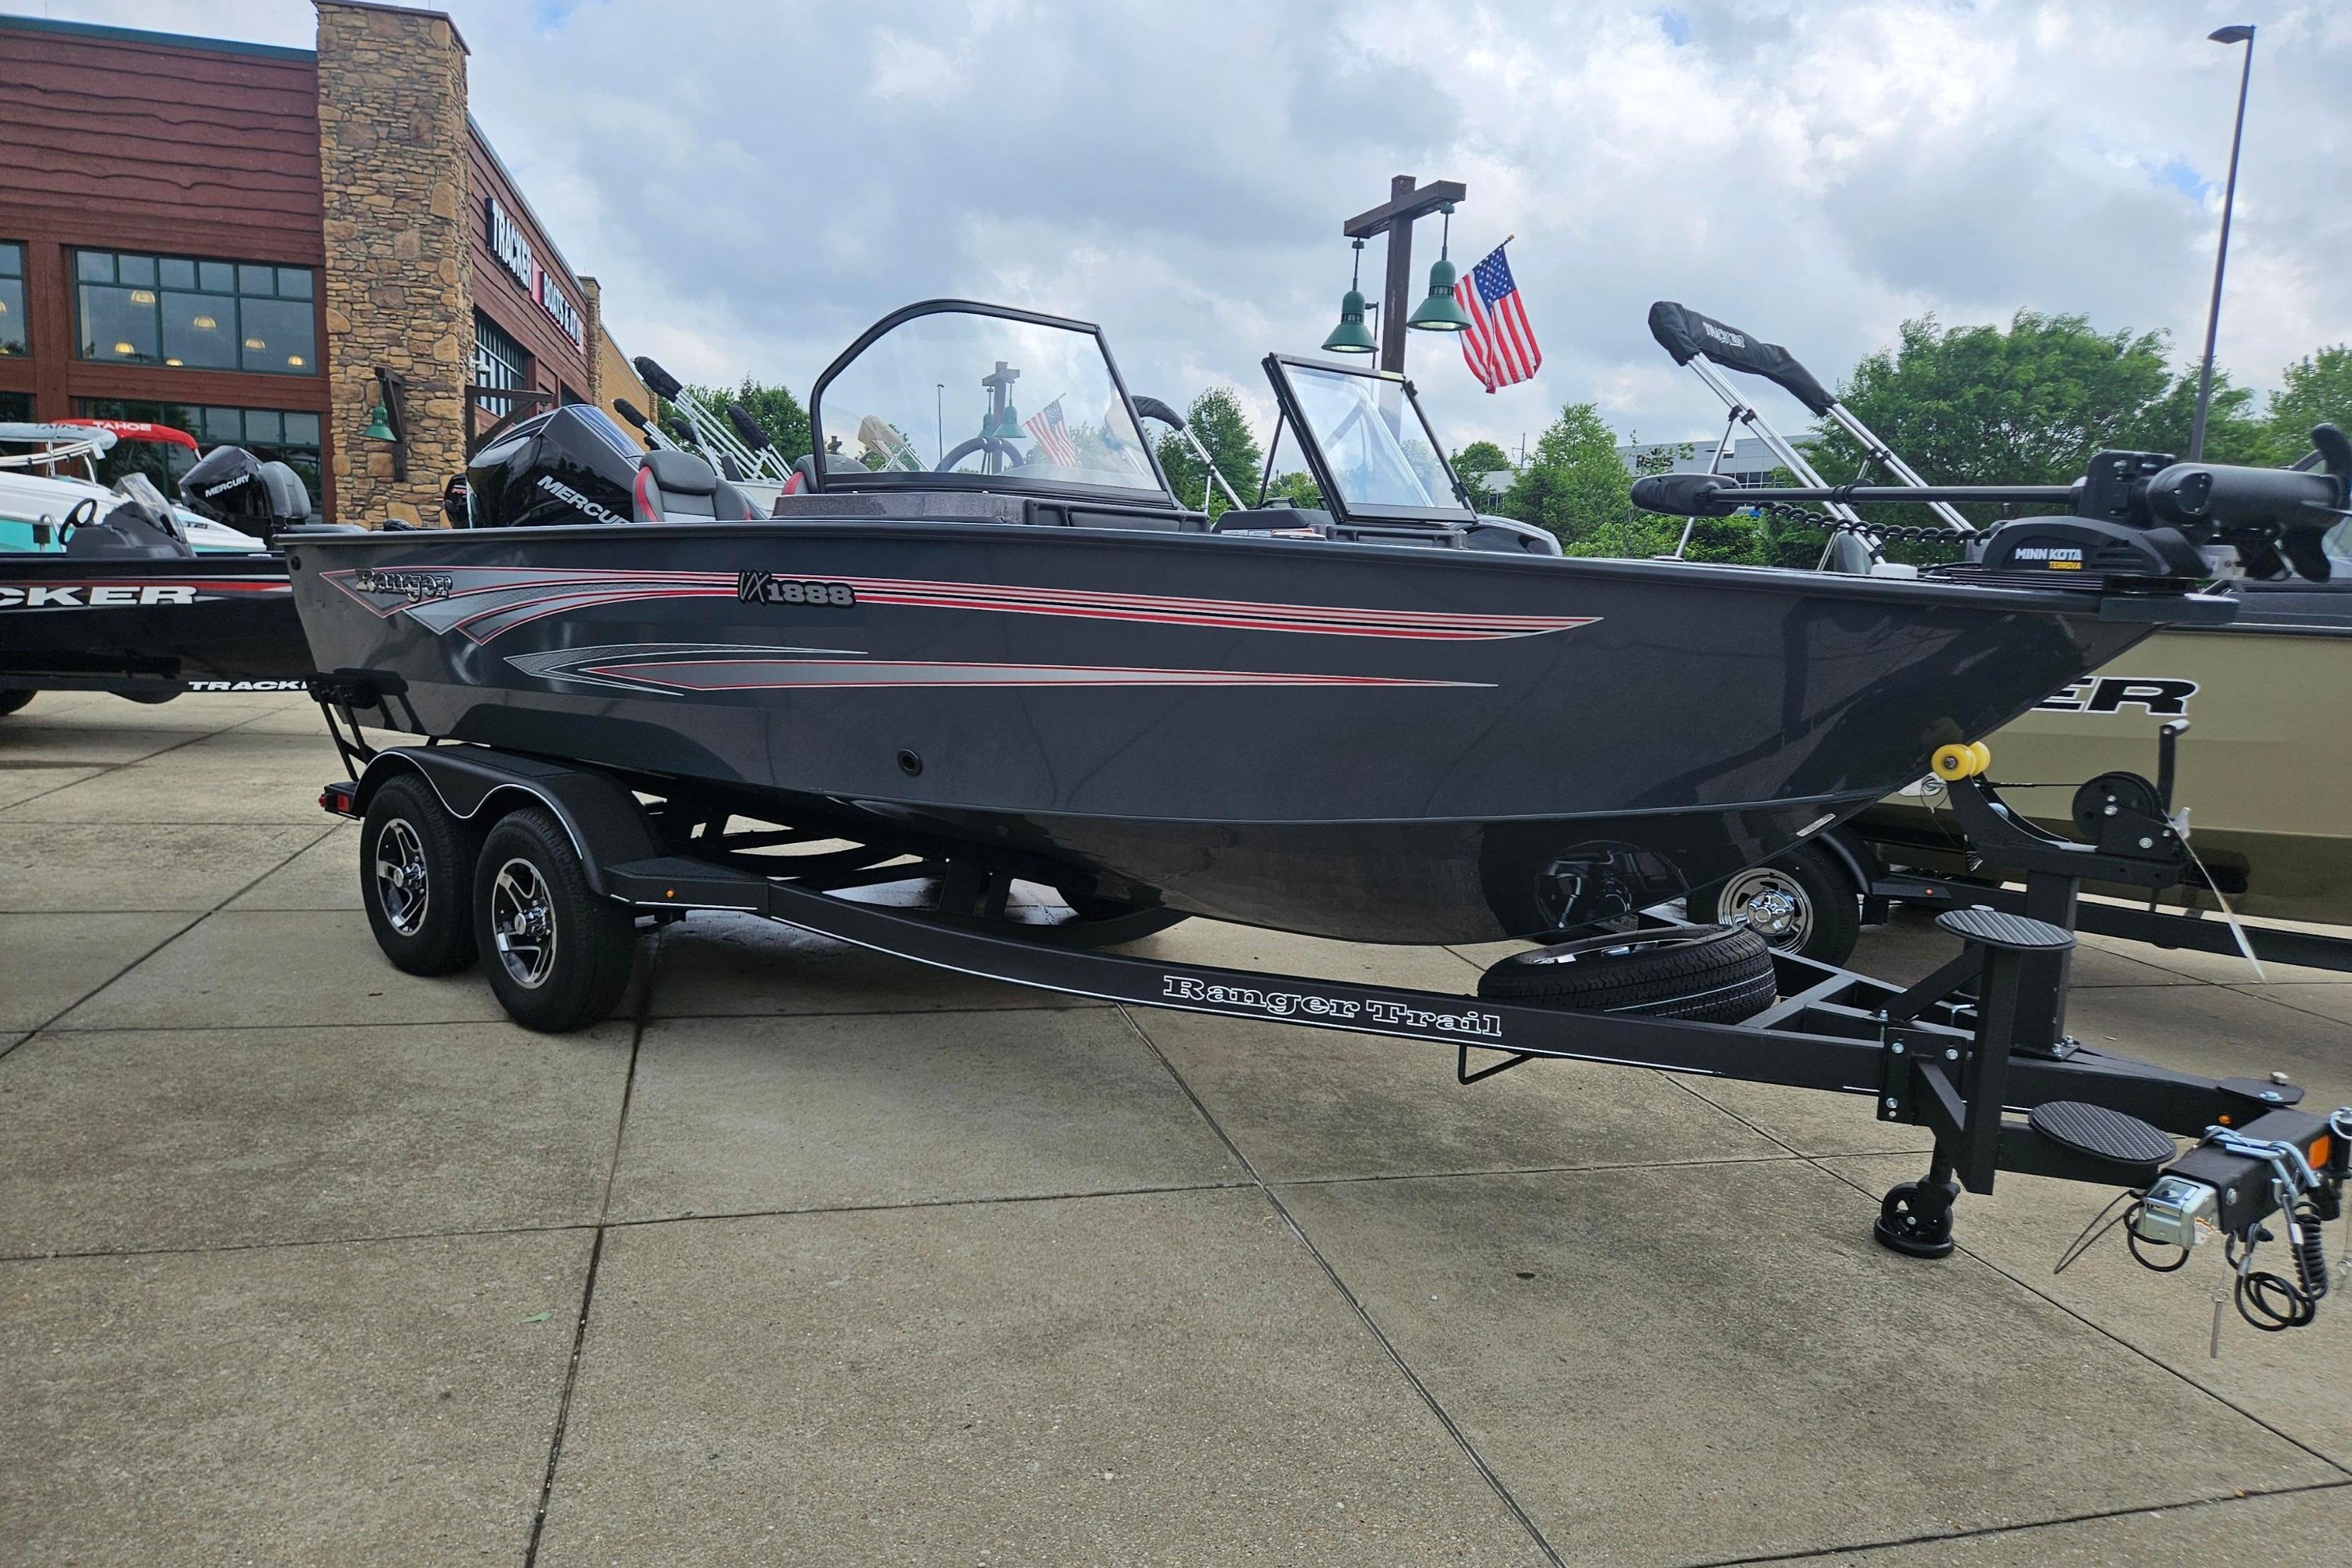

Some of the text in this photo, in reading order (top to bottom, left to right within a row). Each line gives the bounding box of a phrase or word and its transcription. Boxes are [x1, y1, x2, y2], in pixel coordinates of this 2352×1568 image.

[492, 199, 532, 292] TRACKER
[544, 271, 564, 326] BOATS
[1702, 321, 1746, 348] TRACKER
[93, 420, 151, 431] TAHOE
[205, 474, 250, 497] MERCURY
[2014, 548, 2082, 560] MINN KOTA
[2048, 561, 2082, 570] TERROVA
[354, 568, 453, 603] Ranger
[188, 680, 308, 691] TRACK
[1163, 975, 1502, 1037] Ranger Trail
